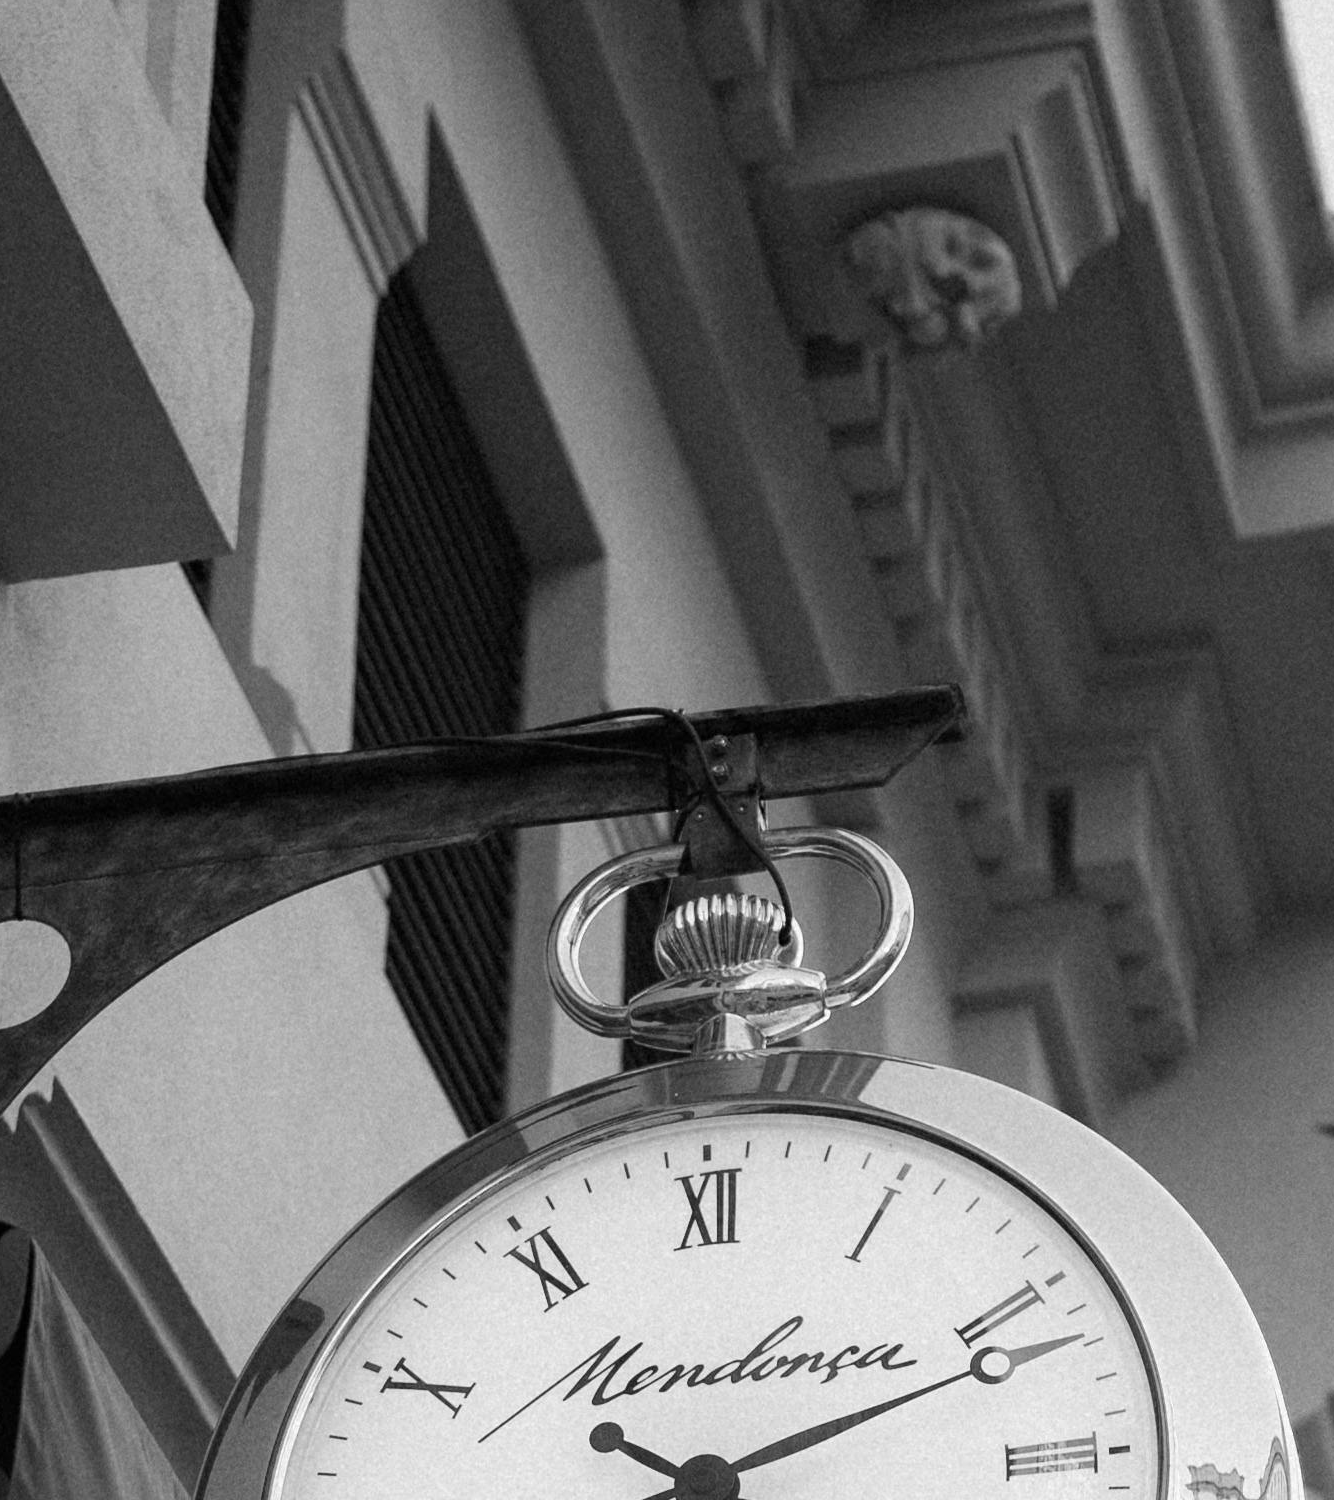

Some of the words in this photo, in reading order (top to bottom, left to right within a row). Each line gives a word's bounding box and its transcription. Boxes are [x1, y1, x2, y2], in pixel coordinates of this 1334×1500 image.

[673, 1167, 743, 1253] XII
[844, 1185, 902, 1264] I
[503, 1225, 590, 1314] XI
[952, 1279, 1046, 1350] II
[379, 1356, 477, 1420] X
[478, 1314, 919, 1444] Mendonça
[1003, 1430, 1100, 1483] III
